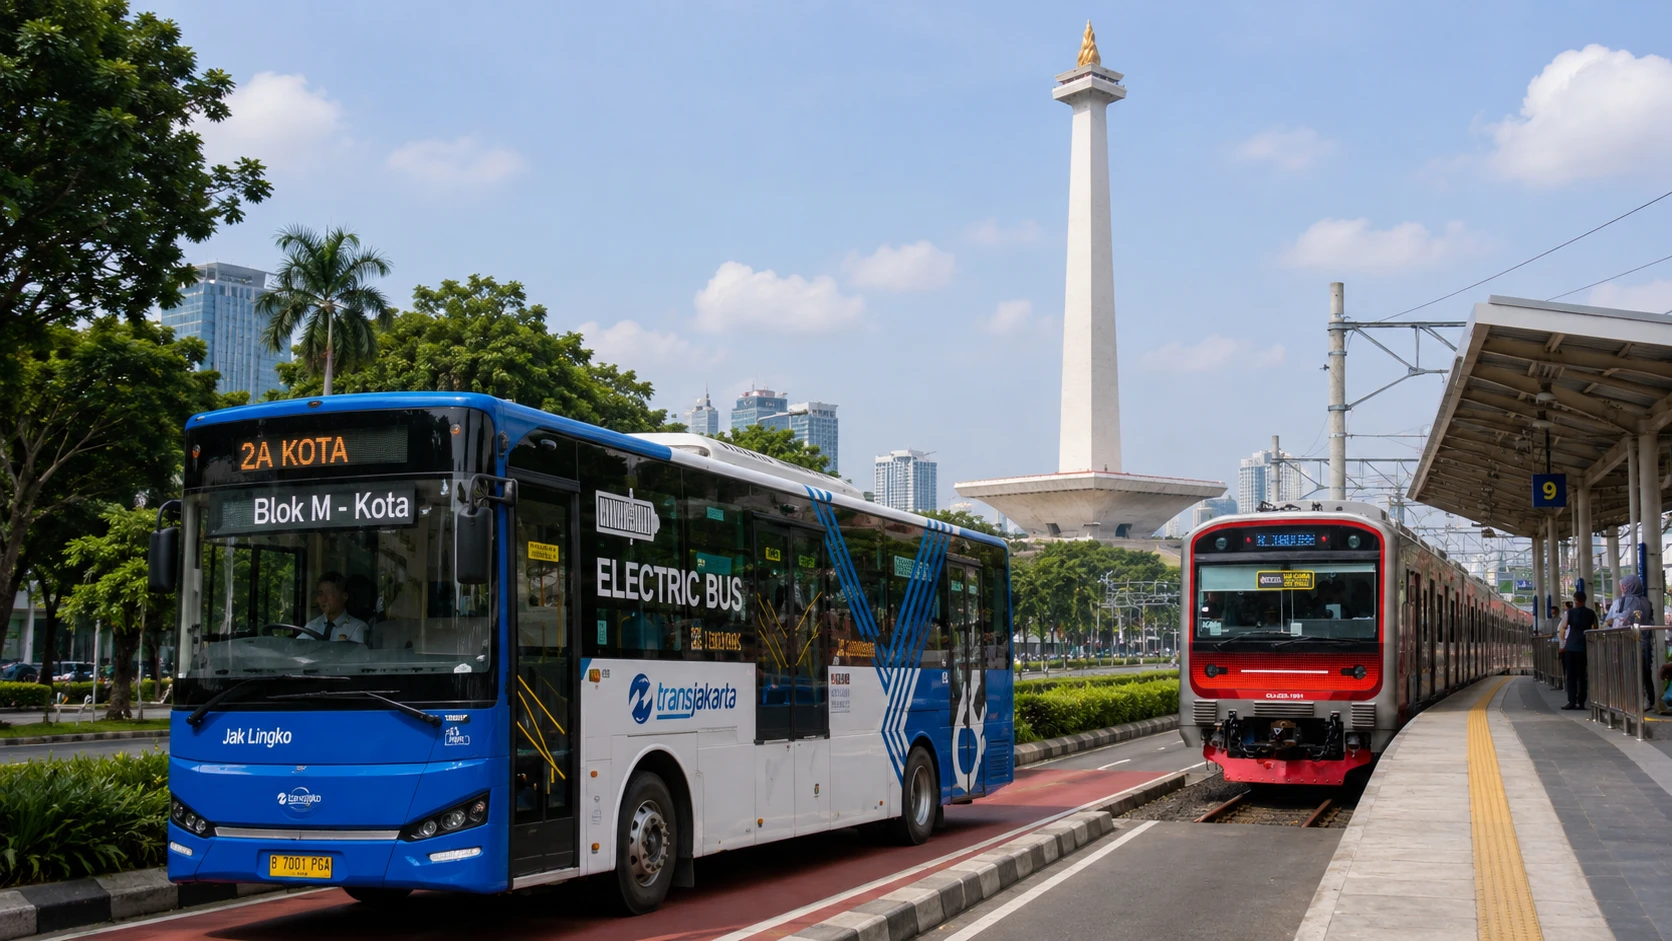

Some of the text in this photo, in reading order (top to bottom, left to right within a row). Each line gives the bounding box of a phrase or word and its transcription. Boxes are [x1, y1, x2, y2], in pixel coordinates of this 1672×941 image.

[240, 436, 349, 471] 2A KOTA
[253, 495, 305, 525] Blok
[311, 494, 331, 522] M
[355, 491, 409, 520] Kota
[1542, 481, 1558, 501] 9
[596, 557, 743, 612] ELECTRIC BUS
[656, 682, 737, 718] transjakarta
[222, 727, 292, 748] Jak Lingko
[271, 856, 277, 869] B
[283, 856, 306, 870] 7001
